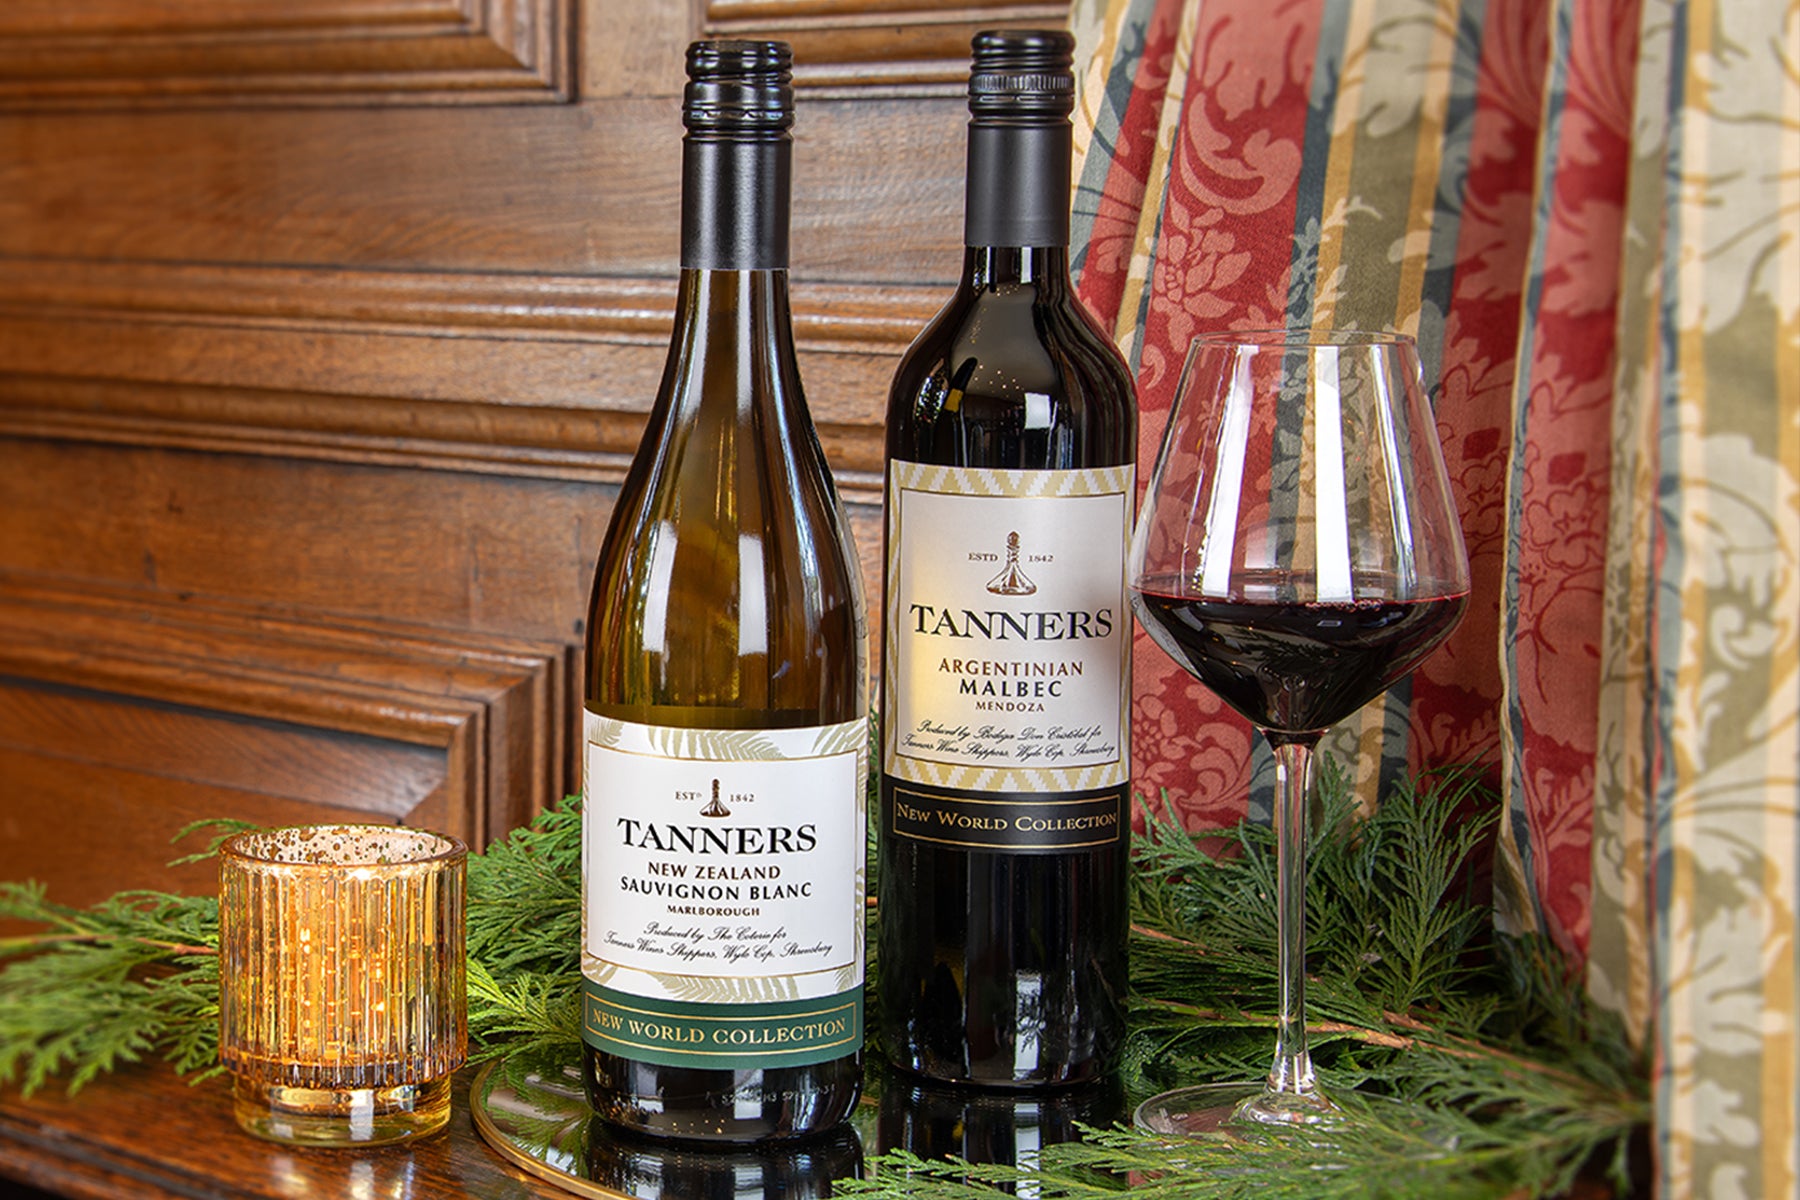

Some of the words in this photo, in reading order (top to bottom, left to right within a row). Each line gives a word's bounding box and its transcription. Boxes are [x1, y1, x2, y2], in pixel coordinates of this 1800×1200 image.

[968, 552, 998, 562] ESTD
[1028, 554, 1053, 563] 1842
[909, 603, 1113, 641] TANNERS
[938, 657, 1083, 677] ARGENTINIAN
[959, 678, 1062, 697] MALBEC
[975, 700, 1045, 712] MENDOZA
[917, 719, 961, 736] Produced
[957, 726, 970, 741] by
[1017, 727, 1043, 740] Don
[1087, 725, 1101, 741] for
[901, 733, 934, 749] Tanners
[1015, 744, 1043, 762] Wyle
[1069, 742, 1115, 757] Shrewsbury
[730, 794, 755, 803] 1842
[617, 818, 816, 855] TANNERS
[648, 861, 688, 877] NEW
[695, 865, 781, 880] ZEALAND
[620, 876, 739, 900] SAUVIGNON
[750, 882, 812, 900] BLANC
[667, 905, 760, 916] MARLBOROUGH
[643, 921, 693, 938] Produced
[690, 928, 704, 944] by
[707, 926, 733, 941] The
[768, 926, 787, 944] for
[603, 930, 635, 949] Tanners
[722, 945, 750, 964] Wyle
[780, 941, 833, 957] Shrewsbury
[592, 1007, 623, 1029] NEW
[628, 1020, 705, 1043] WORLD
[712, 1017, 847, 1045] COLLECTION
